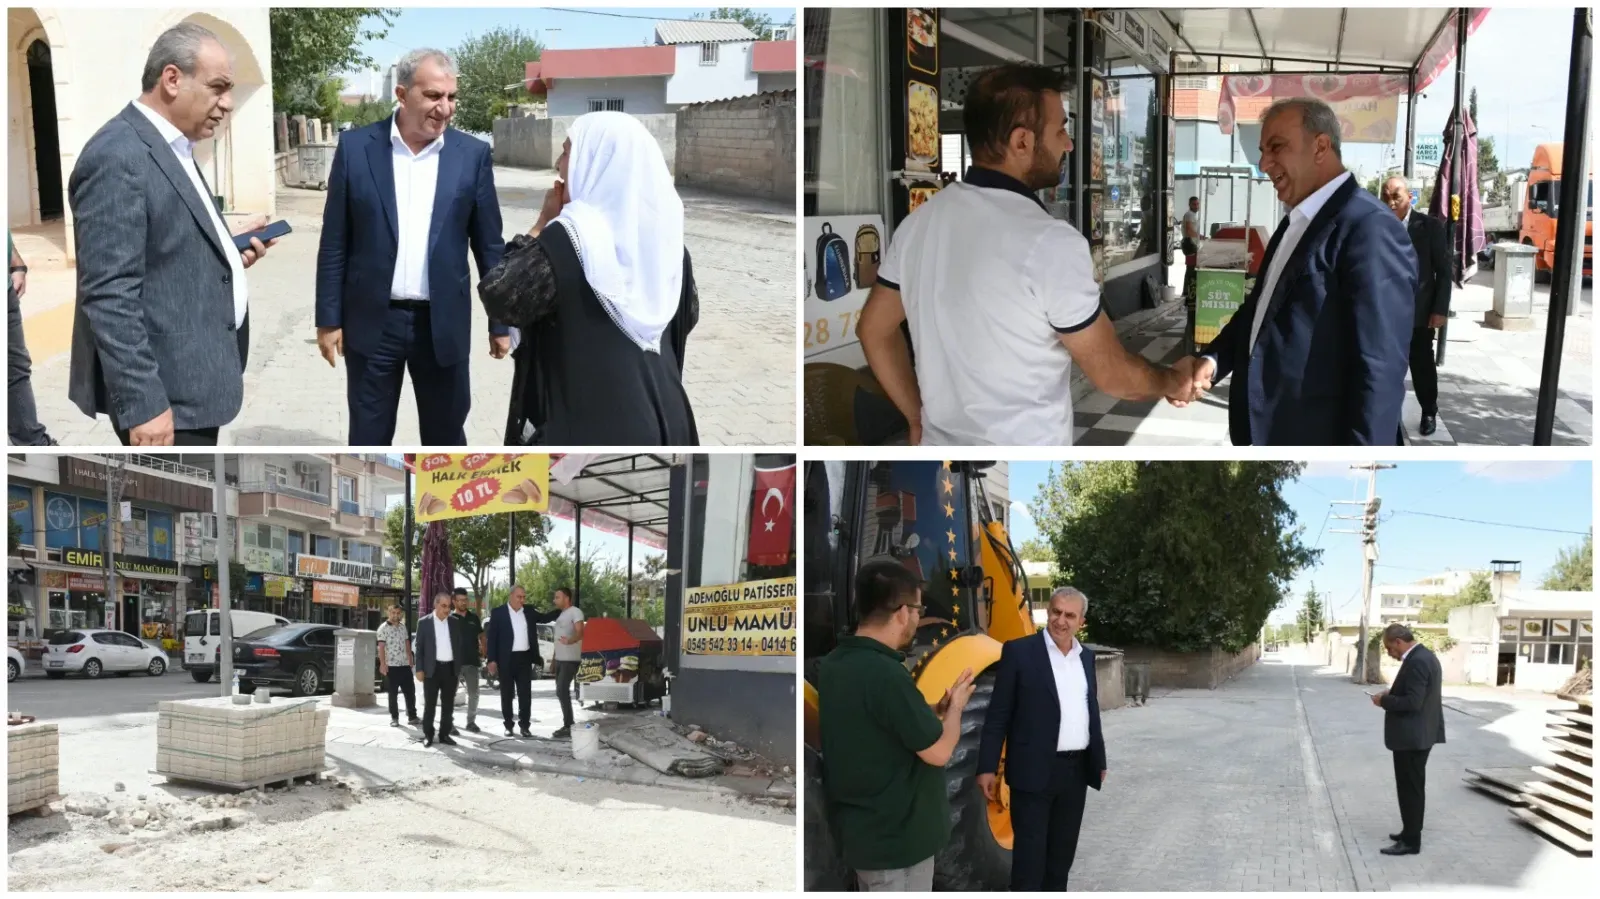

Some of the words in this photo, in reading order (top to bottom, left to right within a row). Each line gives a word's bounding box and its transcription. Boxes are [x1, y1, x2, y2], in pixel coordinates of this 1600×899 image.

[1207, 289, 1231, 301] SÜT
[1201, 300, 1240, 310] MISIR
[804, 317, 830, 348] 28
[424, 456, 449, 470] ŞOK
[465, 453, 488, 469] ŞOK
[432, 470, 466, 484] HALK
[457, 488, 474, 506] 10
[475, 481, 493, 499] TL
[66, 552, 103, 567] EMİR
[115, 561, 132, 570] NLU
[688, 587, 740, 604] ADEMOĞLU
[688, 615, 728, 633] UNLU
[733, 607, 796, 632] MAMÜ
[687, 637, 706, 651] 0545
[708, 637, 724, 651] 542
[727, 637, 738, 652] 33
[741, 637, 752, 651] 14
[761, 637, 787, 652] 0414
